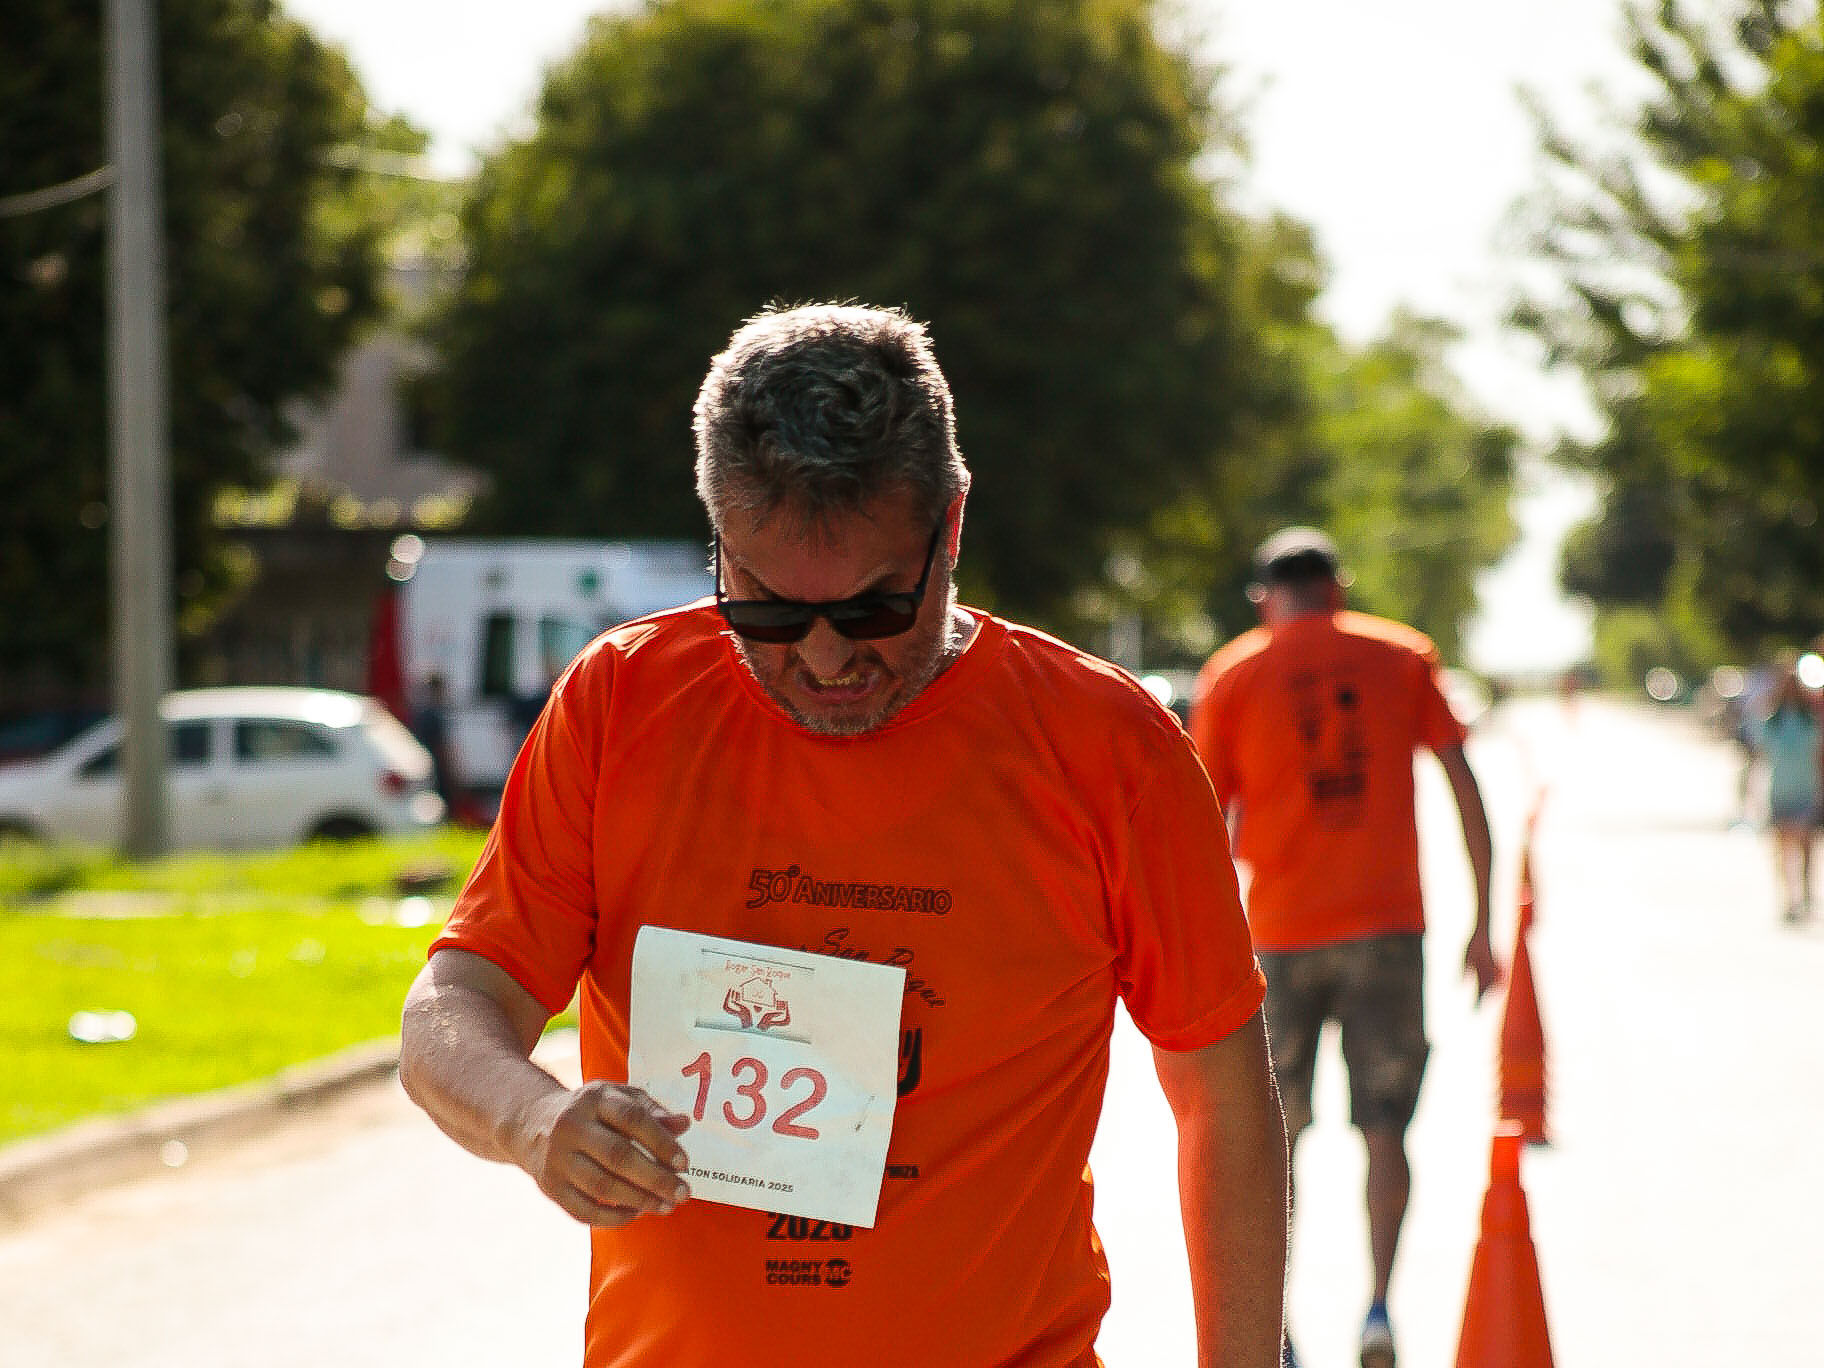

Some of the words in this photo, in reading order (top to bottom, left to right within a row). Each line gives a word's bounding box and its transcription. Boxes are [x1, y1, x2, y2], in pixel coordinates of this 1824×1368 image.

[792, 875, 953, 914] ANIVERSARIO
[681, 1051, 828, 1140] 132
[711, 1171, 766, 1189] SOLIDARIA
[767, 1182, 794, 1193] 2025
